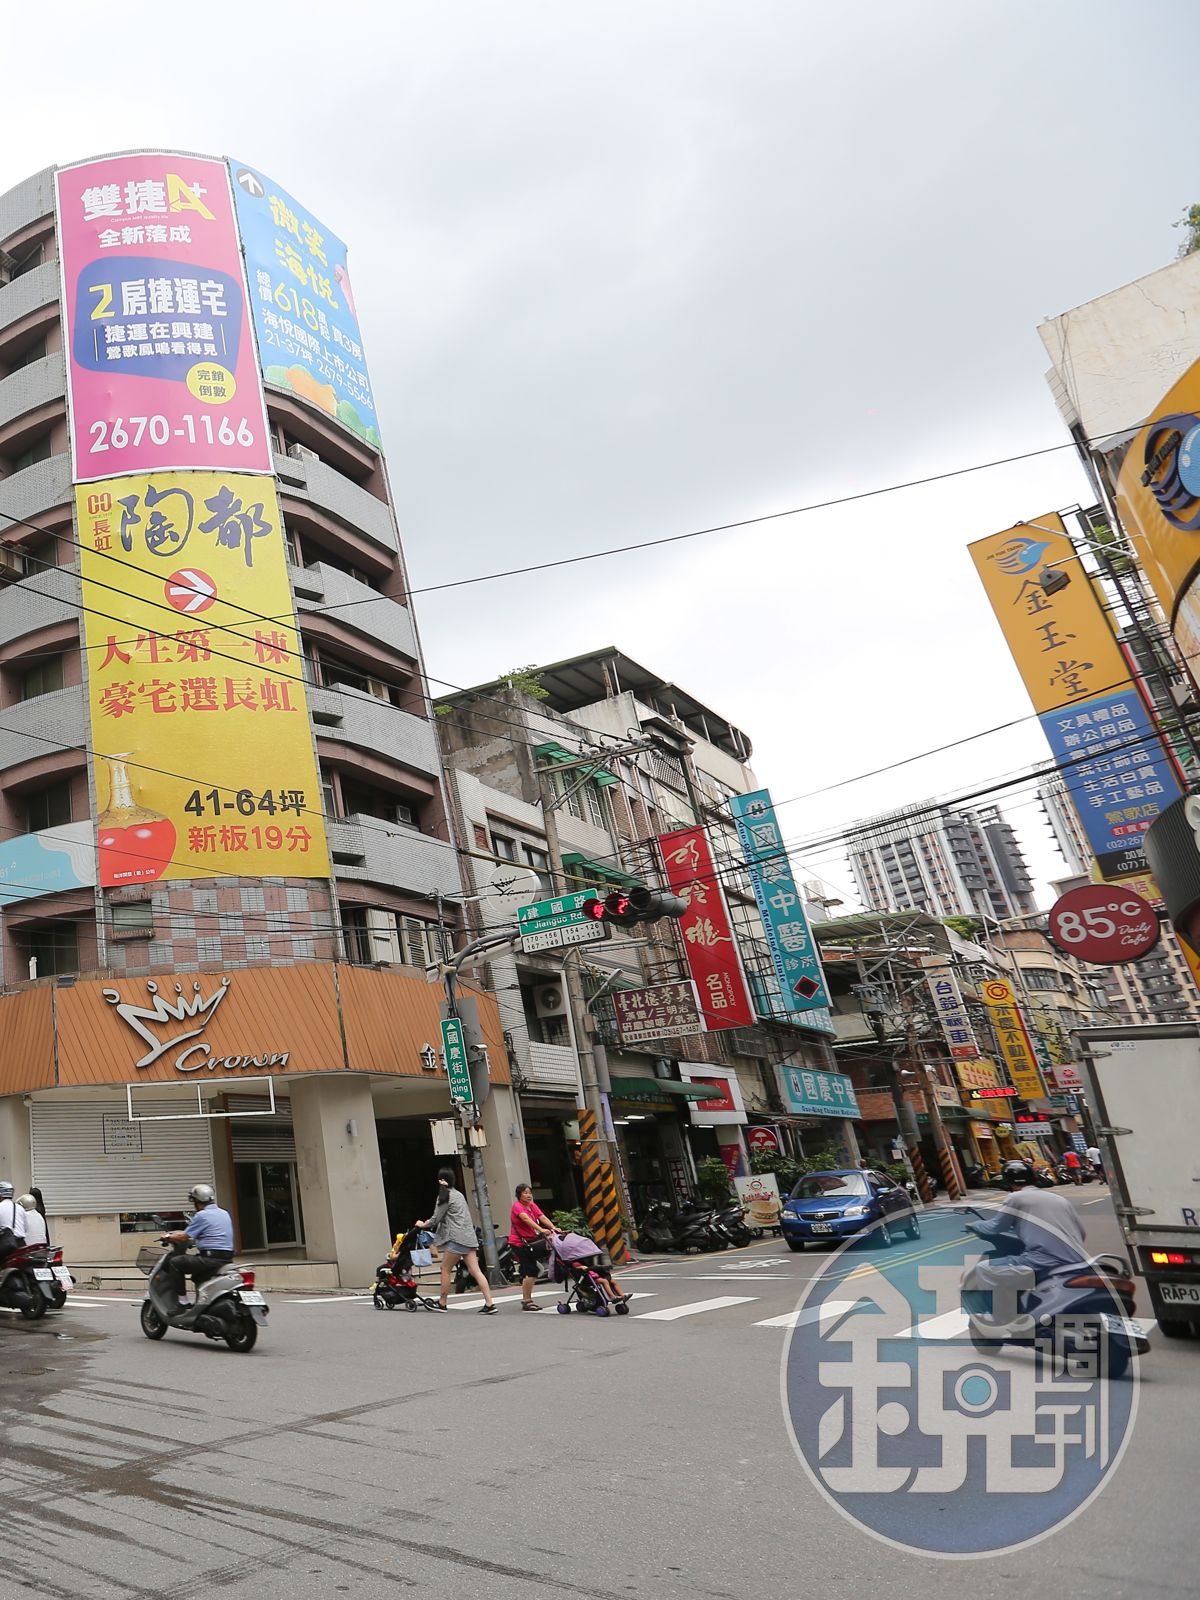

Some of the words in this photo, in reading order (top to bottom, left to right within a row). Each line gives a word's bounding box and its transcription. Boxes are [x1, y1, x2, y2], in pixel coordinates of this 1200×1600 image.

[98, 224, 192, 249] 全新落成
[257, 269, 273, 304] 總價
[275, 282, 319, 331] 618
[105, 321, 214, 344] 捷運在興建
[106, 342, 218, 360] 鶯歌鳳鳴看得見
[197, 368, 224, 383] 完銷
[199, 383, 226, 398] 倒數
[90, 414, 254, 453] 2670-1166
[93, 519, 112, 552] 長虹
[117, 484, 273, 567] 陶都
[97, 629, 291, 671] 人生第一棟
[1013, 579, 1094, 696] 金玉堂
[98, 676, 298, 719] 豪宅選長虹
[1057, 703, 1129, 733] 文具禮品
[1064, 719, 1136, 747] 辦公用品
[1076, 750, 1149, 777] 流行飾品
[1084, 765, 1157, 793] 生活百貨
[184, 789, 307, 818] 41-64坪
[1089, 781, 1164, 808] 手工藝品
[1104, 802, 1161, 825] 鶯歌店
[188, 824, 312, 854] 新板19分
[751, 823, 807, 952] 國慶中醫
[534, 915, 568, 929] Jianguo
[565, 923, 599, 935] 154-126
[1118, 922, 1151, 935] Daily
[526, 932, 557, 944] 170-156
[527, 939, 559, 951] 167-149
[566, 931, 601, 942] 143-115
[762, 909, 777, 953] Medicine
[774, 953, 785, 983] Clinic
[1120, 934, 1150, 946] Cafe
[706, 973, 728, 1010] 名品
[990, 1004, 1031, 1073] 永慶不動產
[175, 1043, 290, 1072] Crown
[446, 1031, 464, 1075] 國慶街
[451, 1077, 469, 1085] Guo-
[452, 1085, 468, 1093] qing
[1182, 1208, 1196, 1225] R
